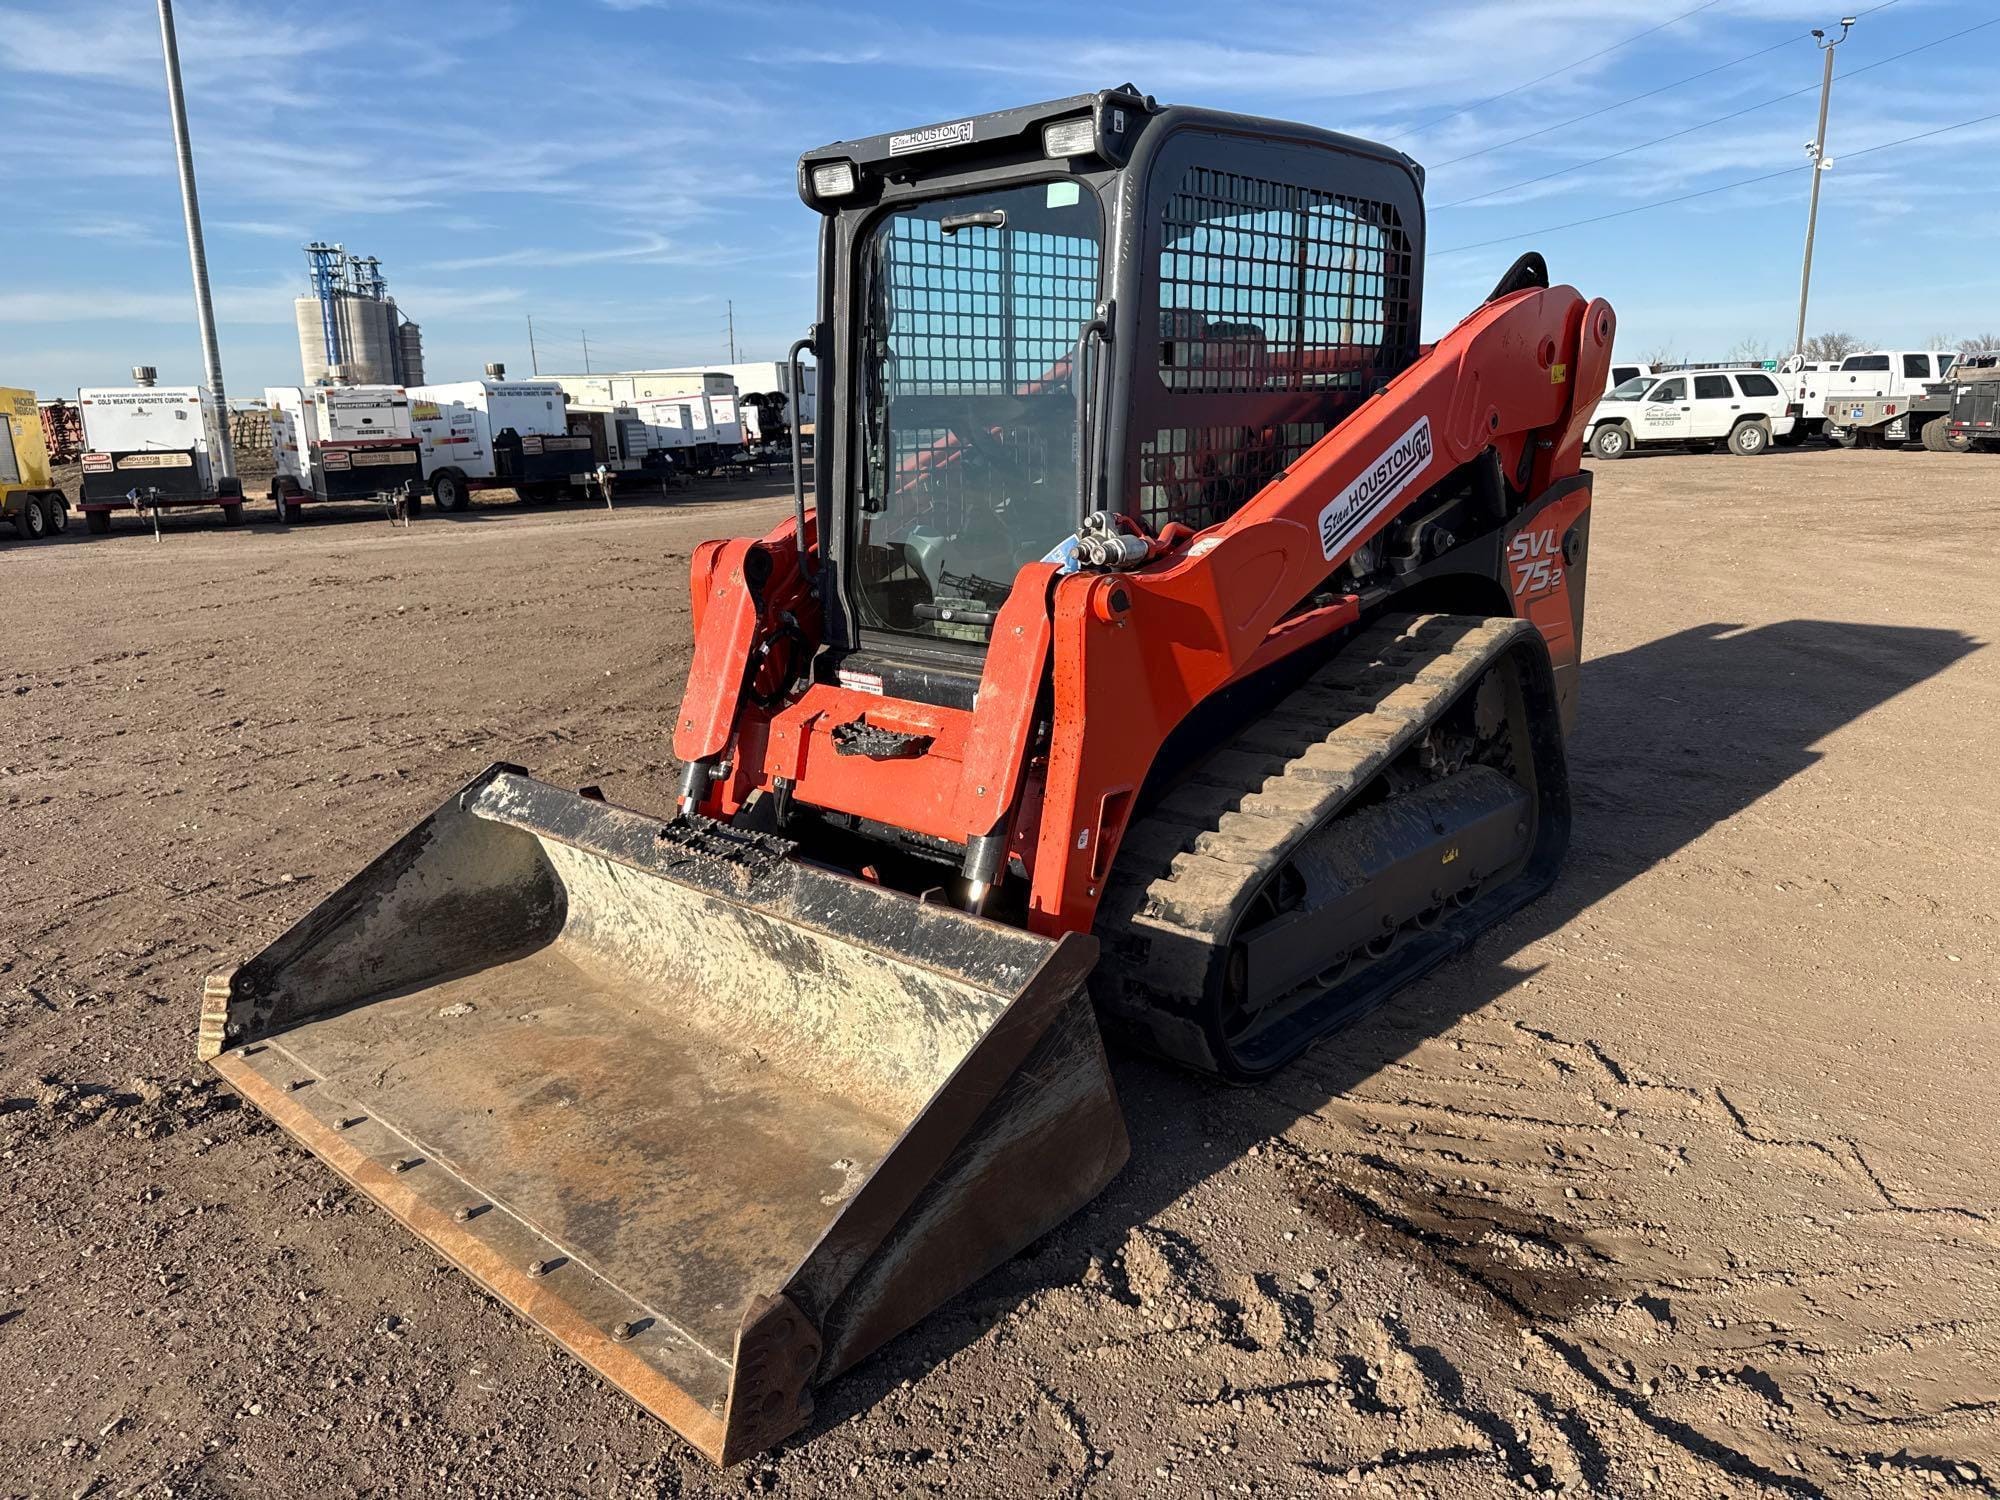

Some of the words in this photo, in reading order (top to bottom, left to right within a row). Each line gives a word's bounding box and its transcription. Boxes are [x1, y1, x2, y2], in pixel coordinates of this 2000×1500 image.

[891, 137, 911, 148] Stan
[911, 125, 956, 143] HOUSTON
[85, 463, 111, 471] FLAMMABLE
[1323, 505, 1349, 540] Stan
[1348, 439, 1413, 513] HOUSTON
[1508, 529, 1561, 563] SVL
[1515, 559, 1562, 595] 75-2
